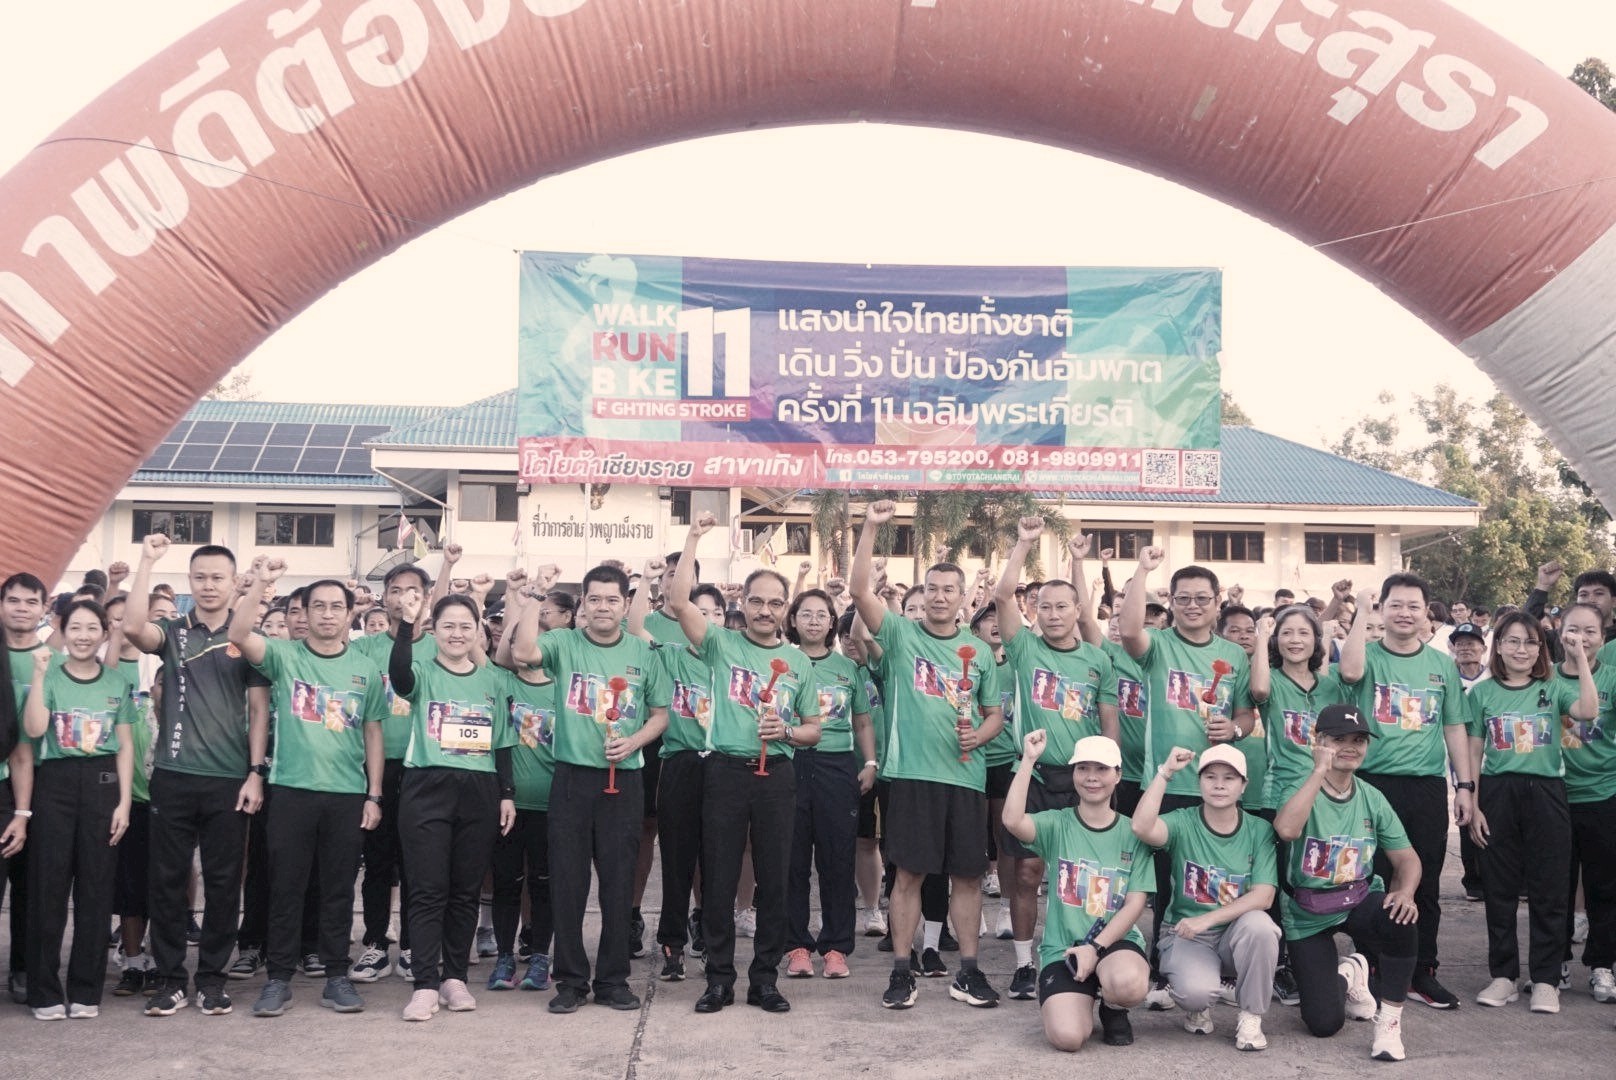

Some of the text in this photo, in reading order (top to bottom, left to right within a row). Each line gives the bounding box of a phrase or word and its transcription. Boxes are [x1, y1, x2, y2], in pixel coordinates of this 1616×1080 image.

[593, 304, 678, 327] WALK
[778, 296, 1073, 337] แสงนำใจไทยทั้งชาติ
[592, 331, 677, 362] RUN
[676, 306, 751, 398] 11
[778, 339, 1162, 384] เดิน วิ่ง ปั่น ป้องกันอัมพาต
[592, 366, 677, 396] BKE
[596, 401, 747, 418] FGHTING STROKE
[778, 381, 1133, 428] ครั้งที่ 11 เฉลิมพระเกียรติ
[522, 450, 804, 480] โตโยต้าเชียงราย สาขาเทิง
[1002, 449, 1141, 468] 081-9809911
[171, 722, 183, 758] ARMY
[459, 728, 479, 739] 105
